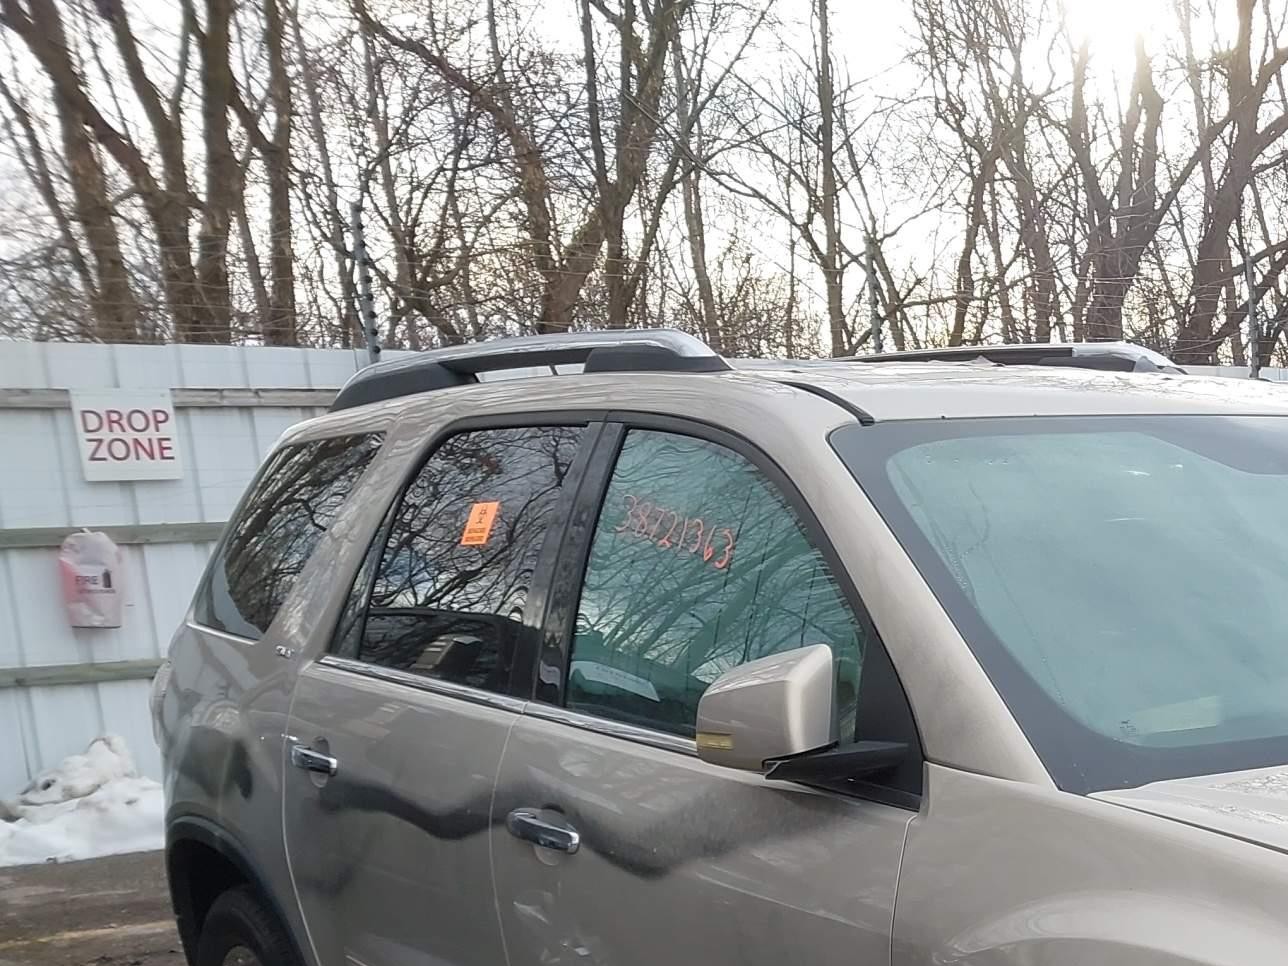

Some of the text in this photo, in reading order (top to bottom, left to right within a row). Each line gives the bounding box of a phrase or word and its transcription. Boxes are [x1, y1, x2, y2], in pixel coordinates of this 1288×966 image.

[80, 409, 169, 433] DROP
[86, 437, 175, 461] ZONE
[614, 494, 733, 569] 38721363
